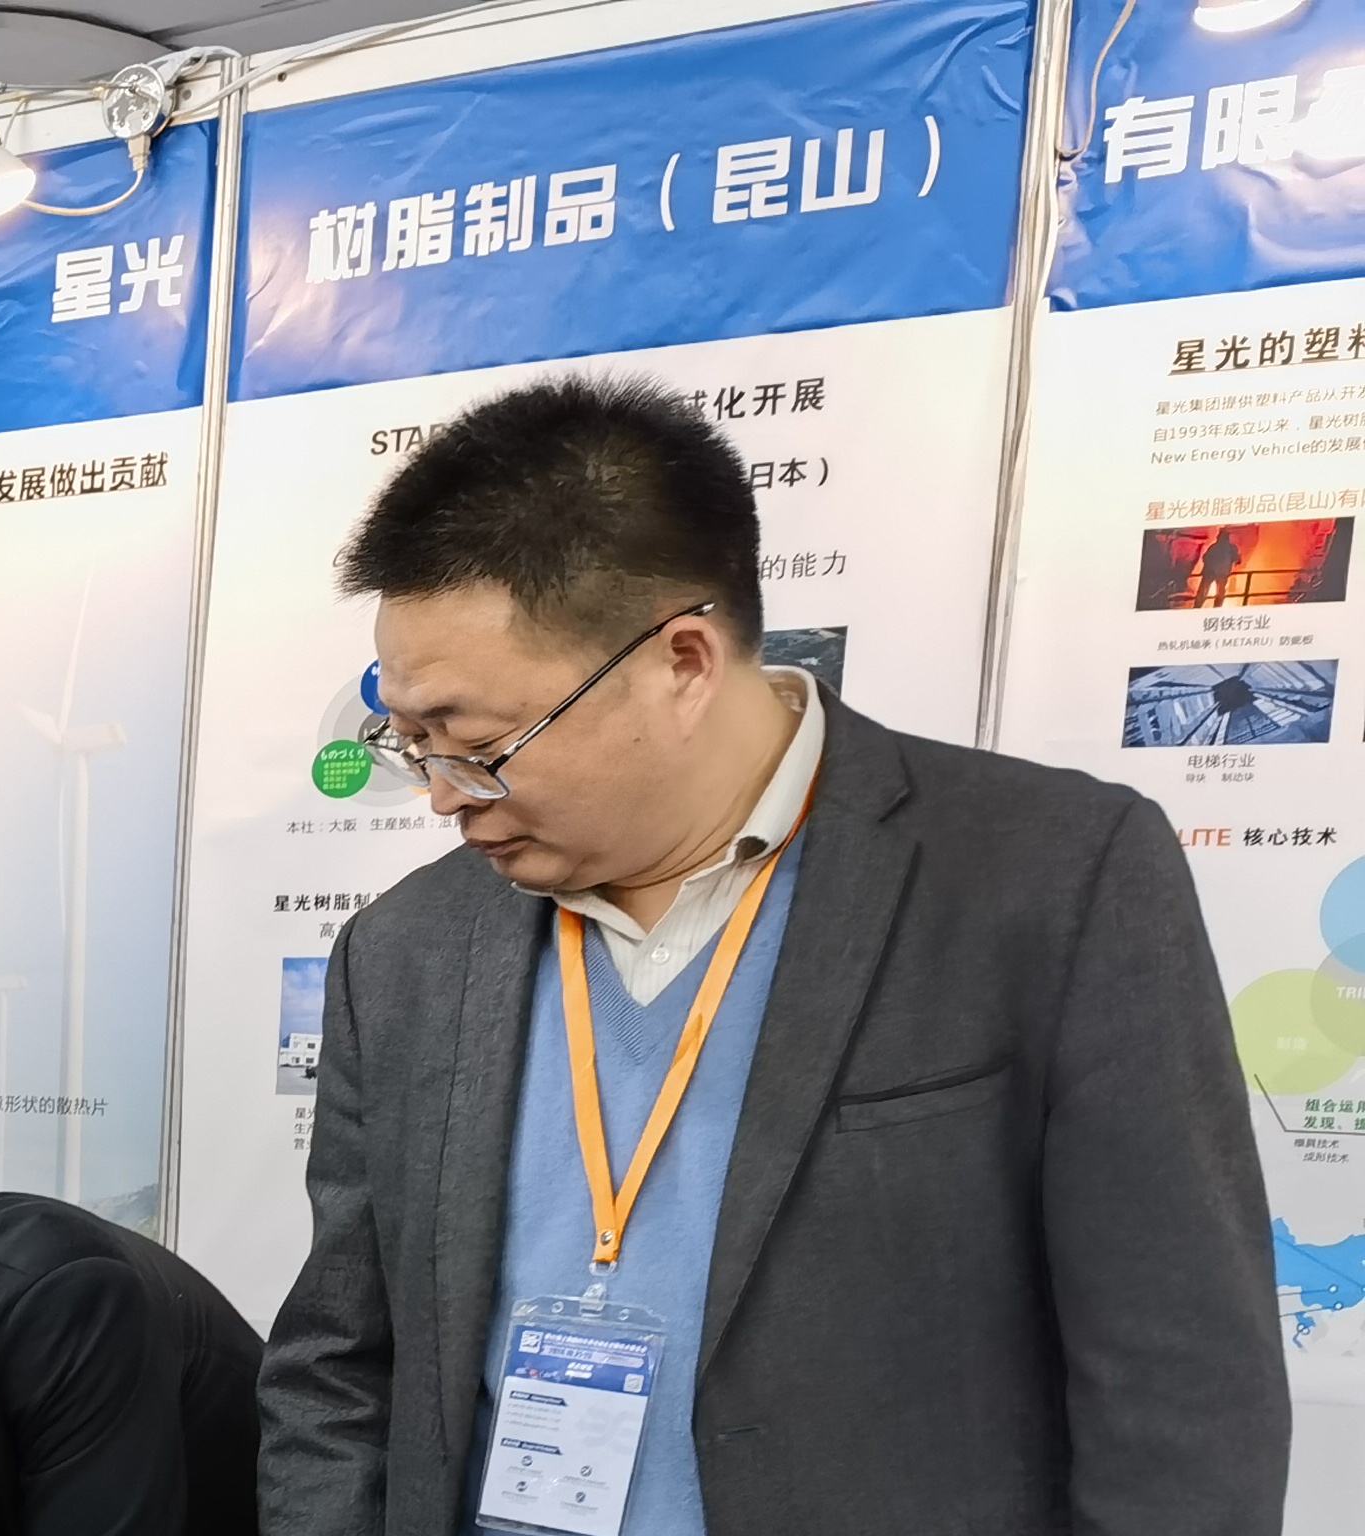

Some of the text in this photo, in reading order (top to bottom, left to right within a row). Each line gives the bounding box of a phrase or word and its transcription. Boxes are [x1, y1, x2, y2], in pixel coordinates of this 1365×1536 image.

[304, 115, 942, 287] 树脂制品（昆山）
[51, 234, 185, 324] 星光
[1150, 452, 1186, 464] New
[1191, 447, 1246, 462] Energy
[1146, 488, 1365, 520] 星光树脂制品(昆山)有
[1203, 614, 1271, 631] 钢铁行业
[1188, 753, 1256, 768] 电梯行业
[1243, 826, 1337, 847] 核心技术
